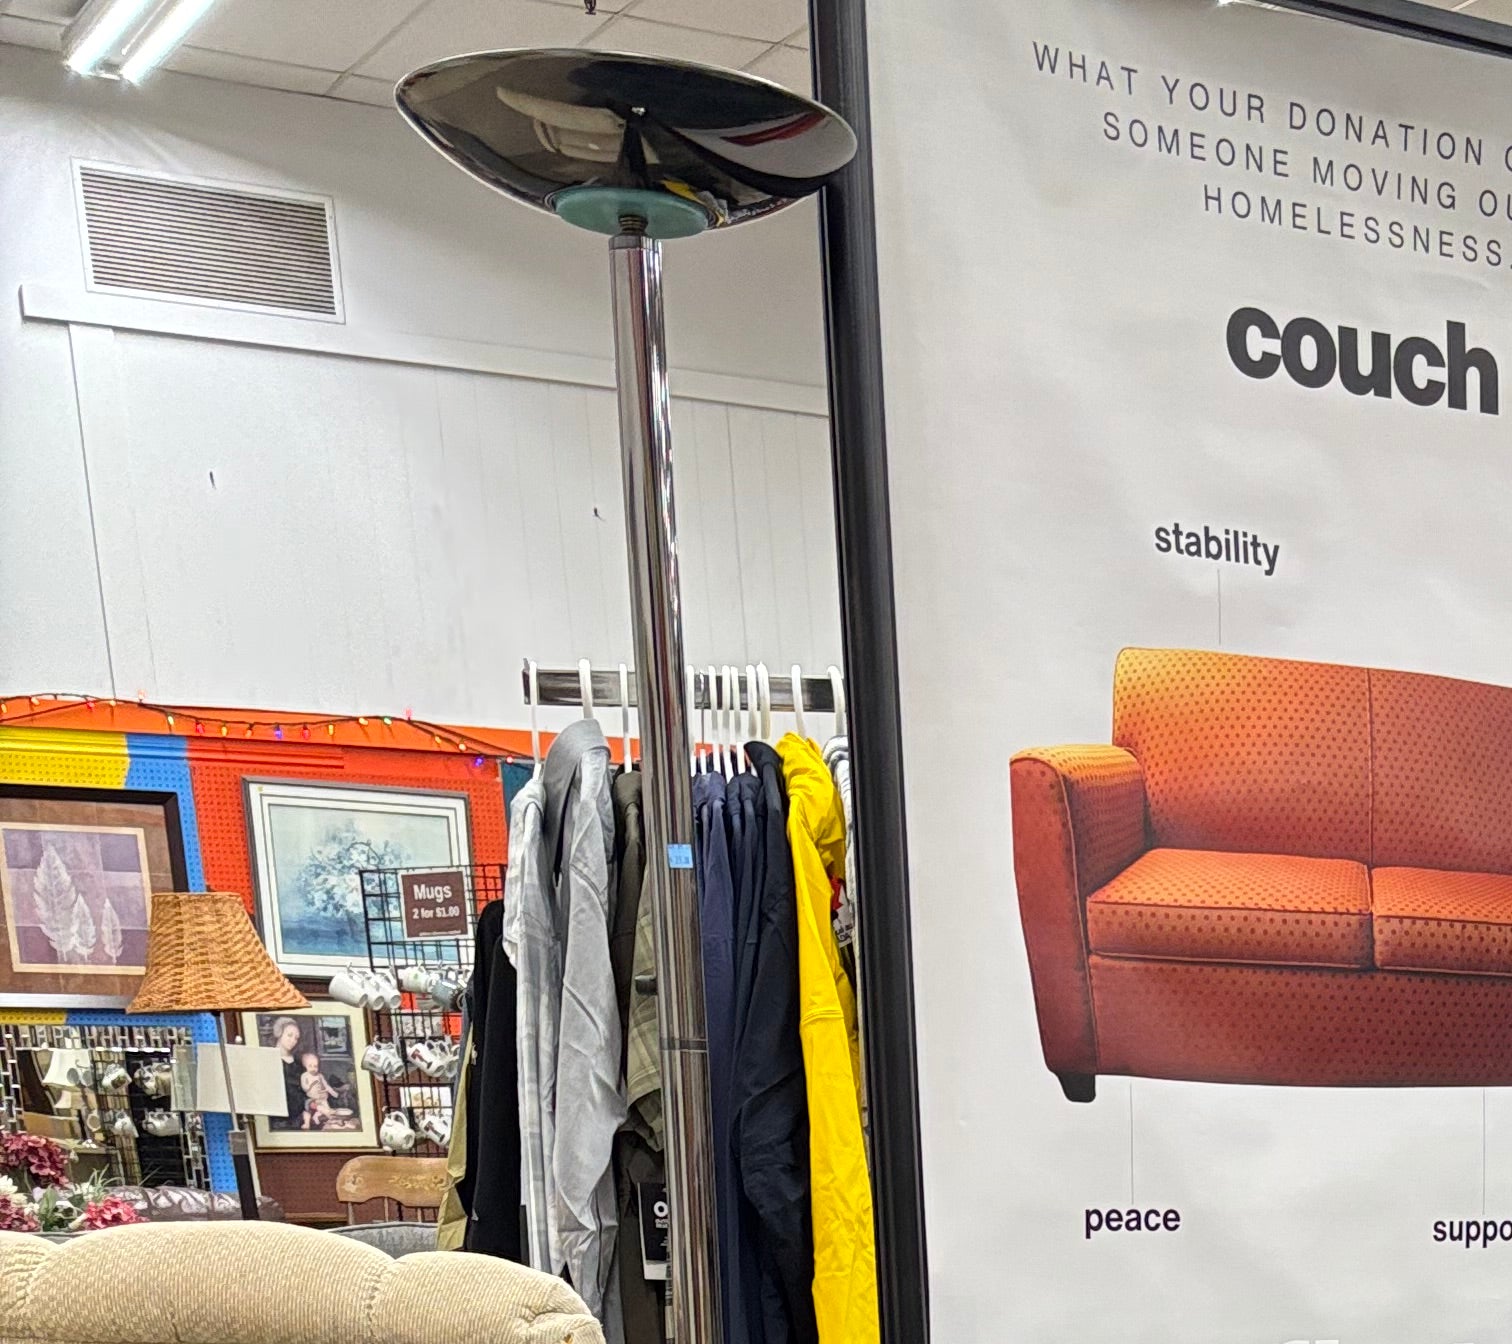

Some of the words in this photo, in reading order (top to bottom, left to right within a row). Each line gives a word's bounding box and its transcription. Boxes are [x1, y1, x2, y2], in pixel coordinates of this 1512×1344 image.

[1032, 40, 1139, 96] WHAT
[1160, 74, 1266, 124] YOUR
[1288, 101, 1484, 166] DONATION
[1102, 111, 1290, 178] SOMEONE
[1312, 155, 1457, 212] MOVING
[1226, 306, 1500, 416] couch
[1154, 522, 1280, 577] stability
[412, 907, 420, 919] 2
[420, 907, 434, 919] for
[435, 905, 460, 918] $1.00
[413, 883, 453, 903] Mugs
[1085, 1208, 1182, 1240] peace
